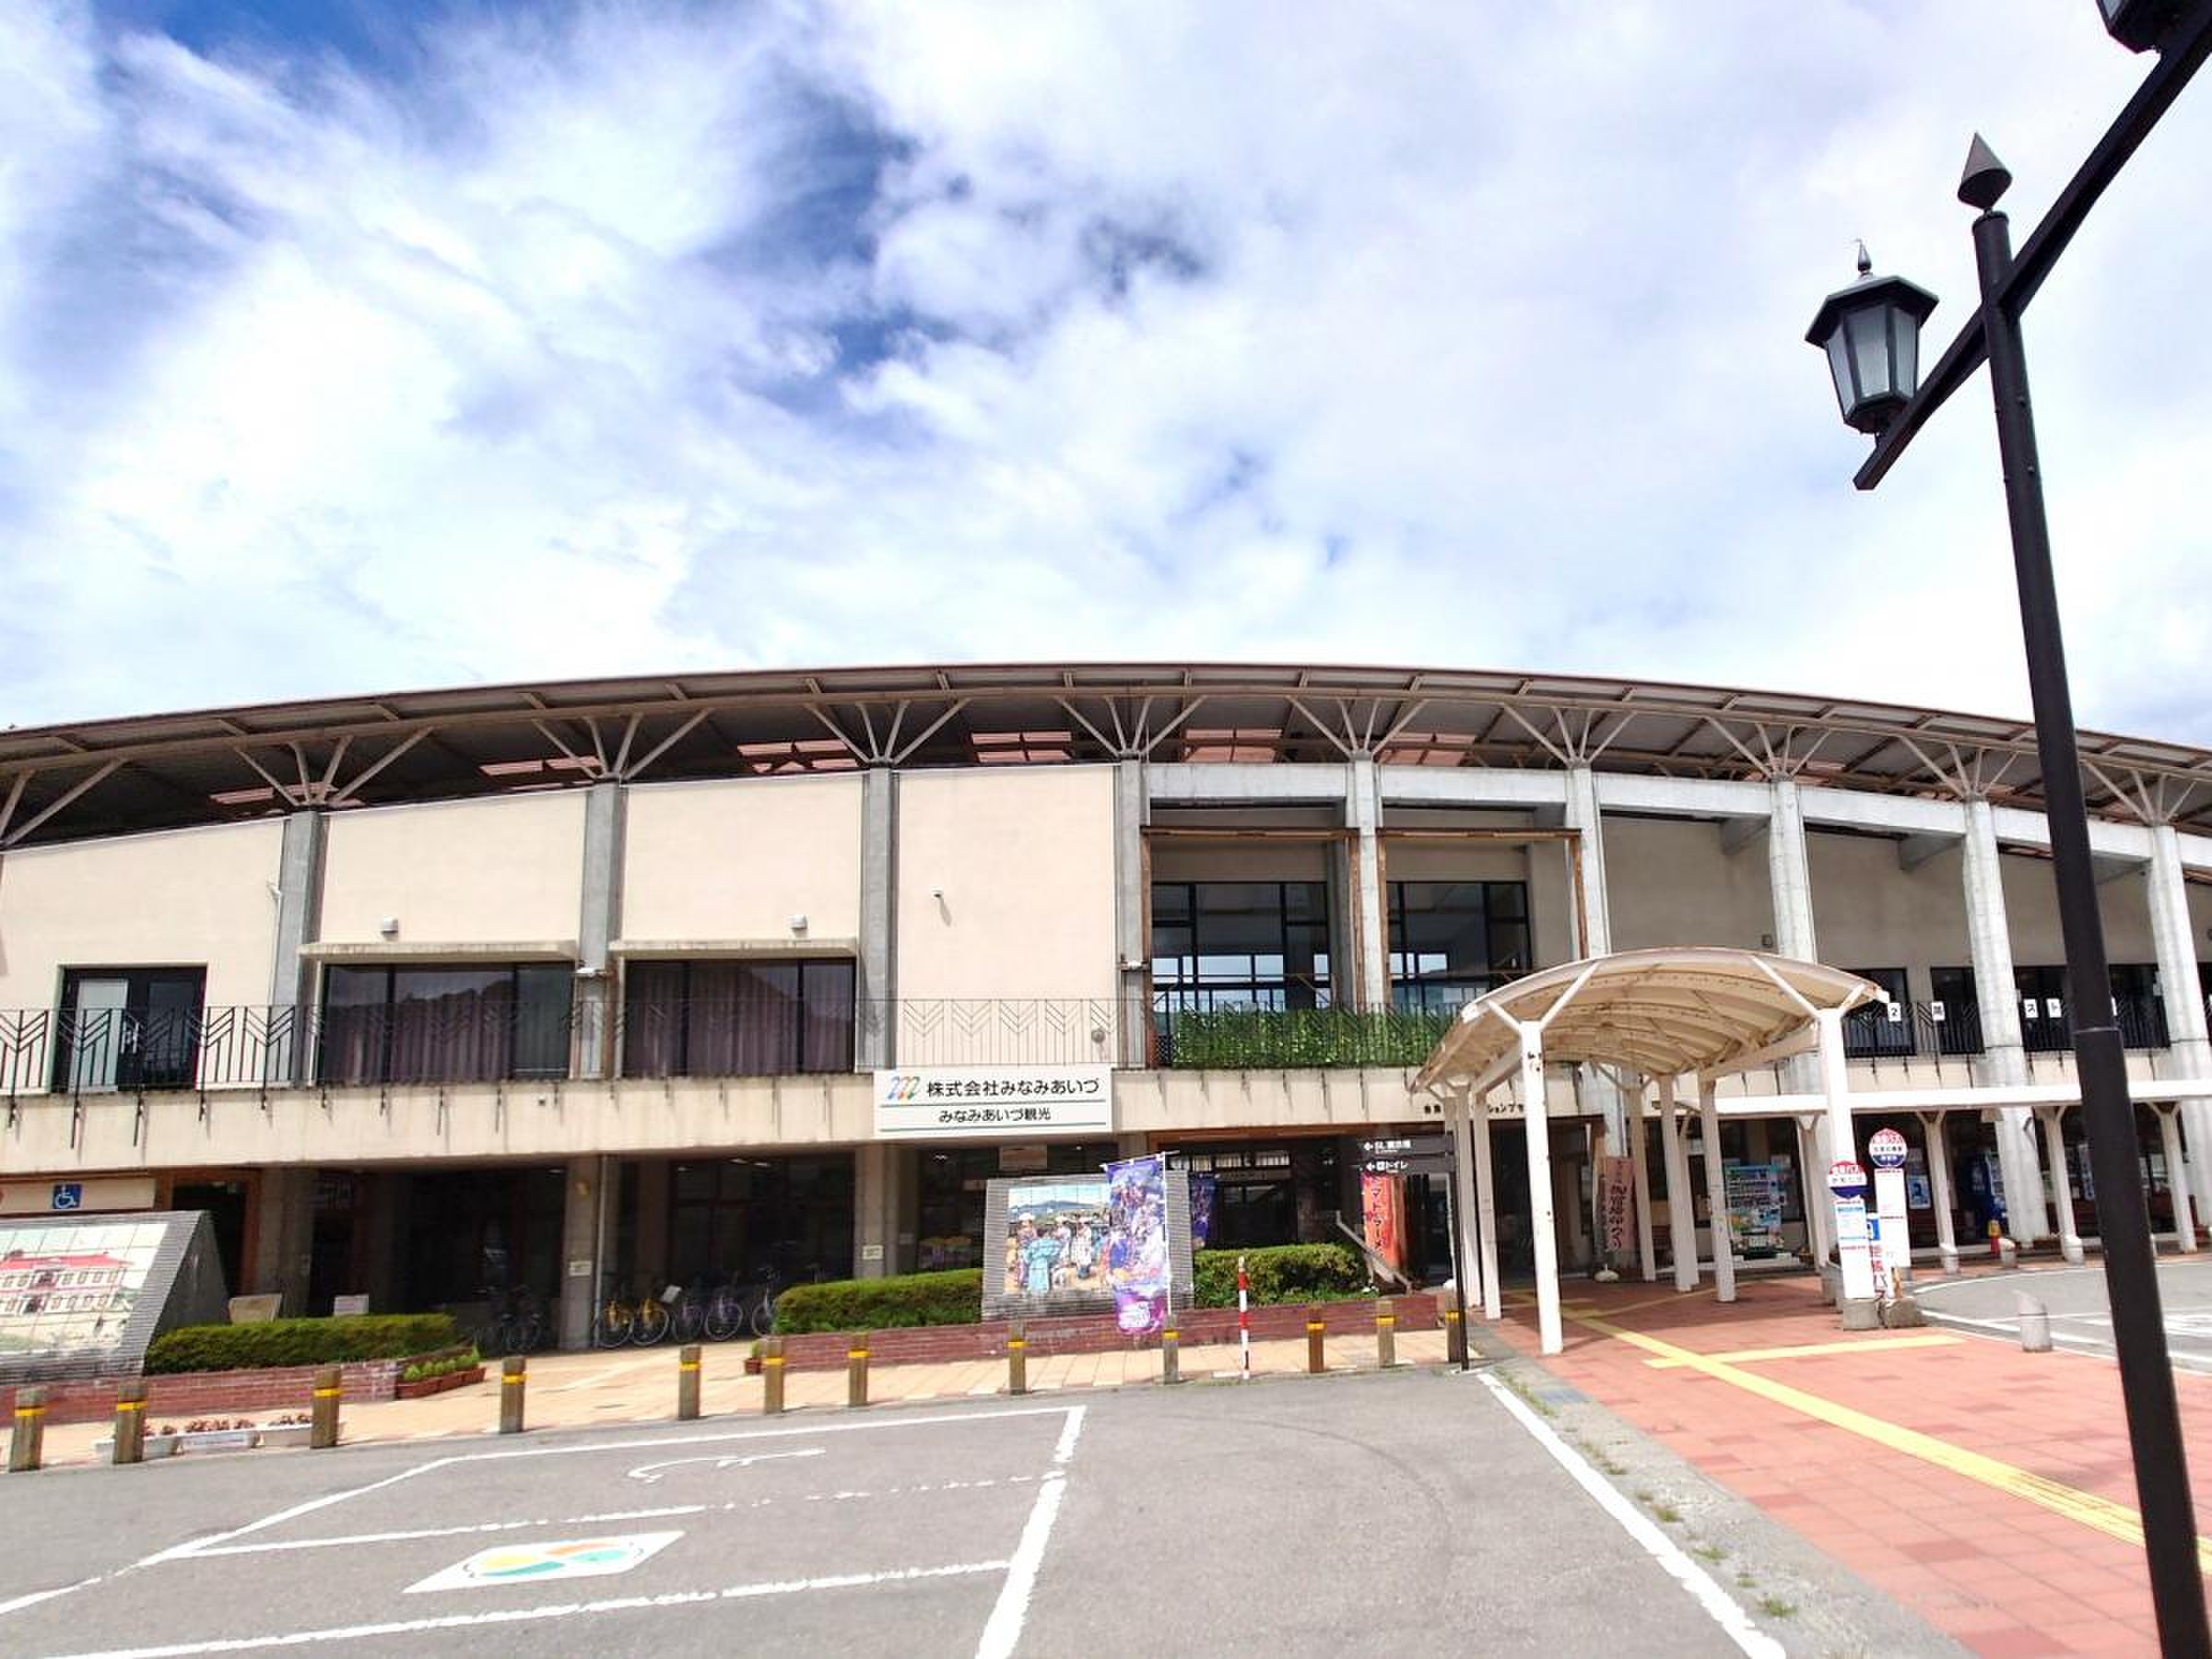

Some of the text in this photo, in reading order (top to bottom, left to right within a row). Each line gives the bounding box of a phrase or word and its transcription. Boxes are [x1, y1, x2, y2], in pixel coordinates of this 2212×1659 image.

[926, 1077, 1100, 1098] 株式会社みなみあいづ
[939, 1107, 1052, 1123] みなみあいづ観光
